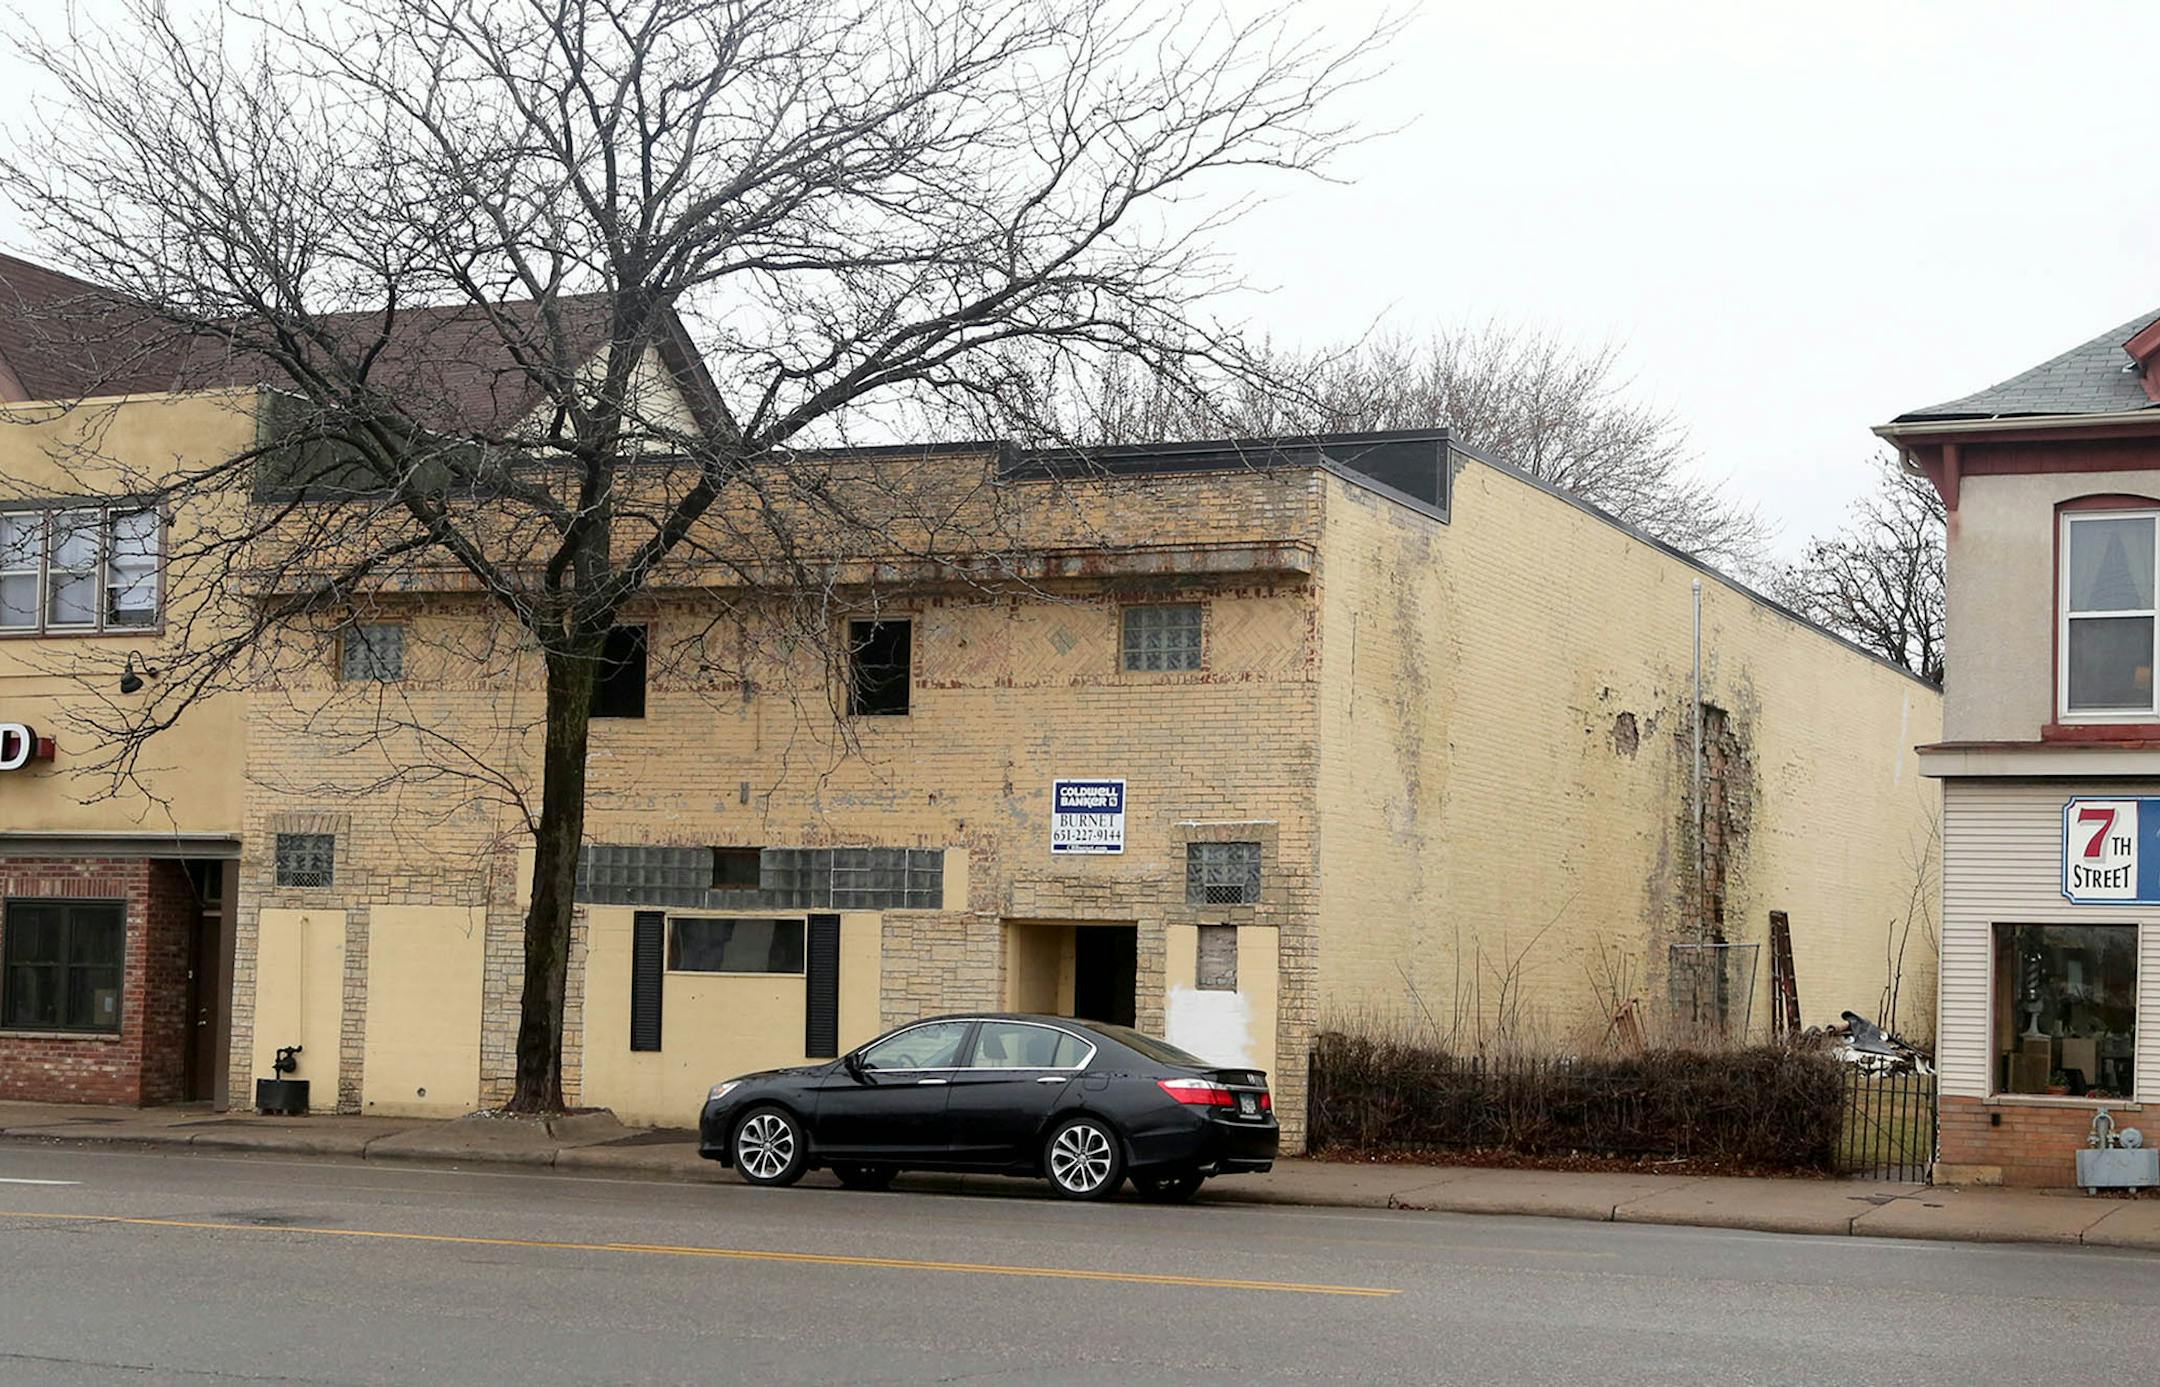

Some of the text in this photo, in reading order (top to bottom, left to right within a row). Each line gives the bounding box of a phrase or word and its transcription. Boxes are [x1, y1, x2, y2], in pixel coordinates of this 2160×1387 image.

[1060, 787, 1118, 796] COLDWELL
[1060, 796, 1107, 808] BANKER
[1060, 814, 1115, 827] BURNET
[1053, 829, 1121, 841] 651-227-9144
[2074, 864, 2131, 888] STREET
